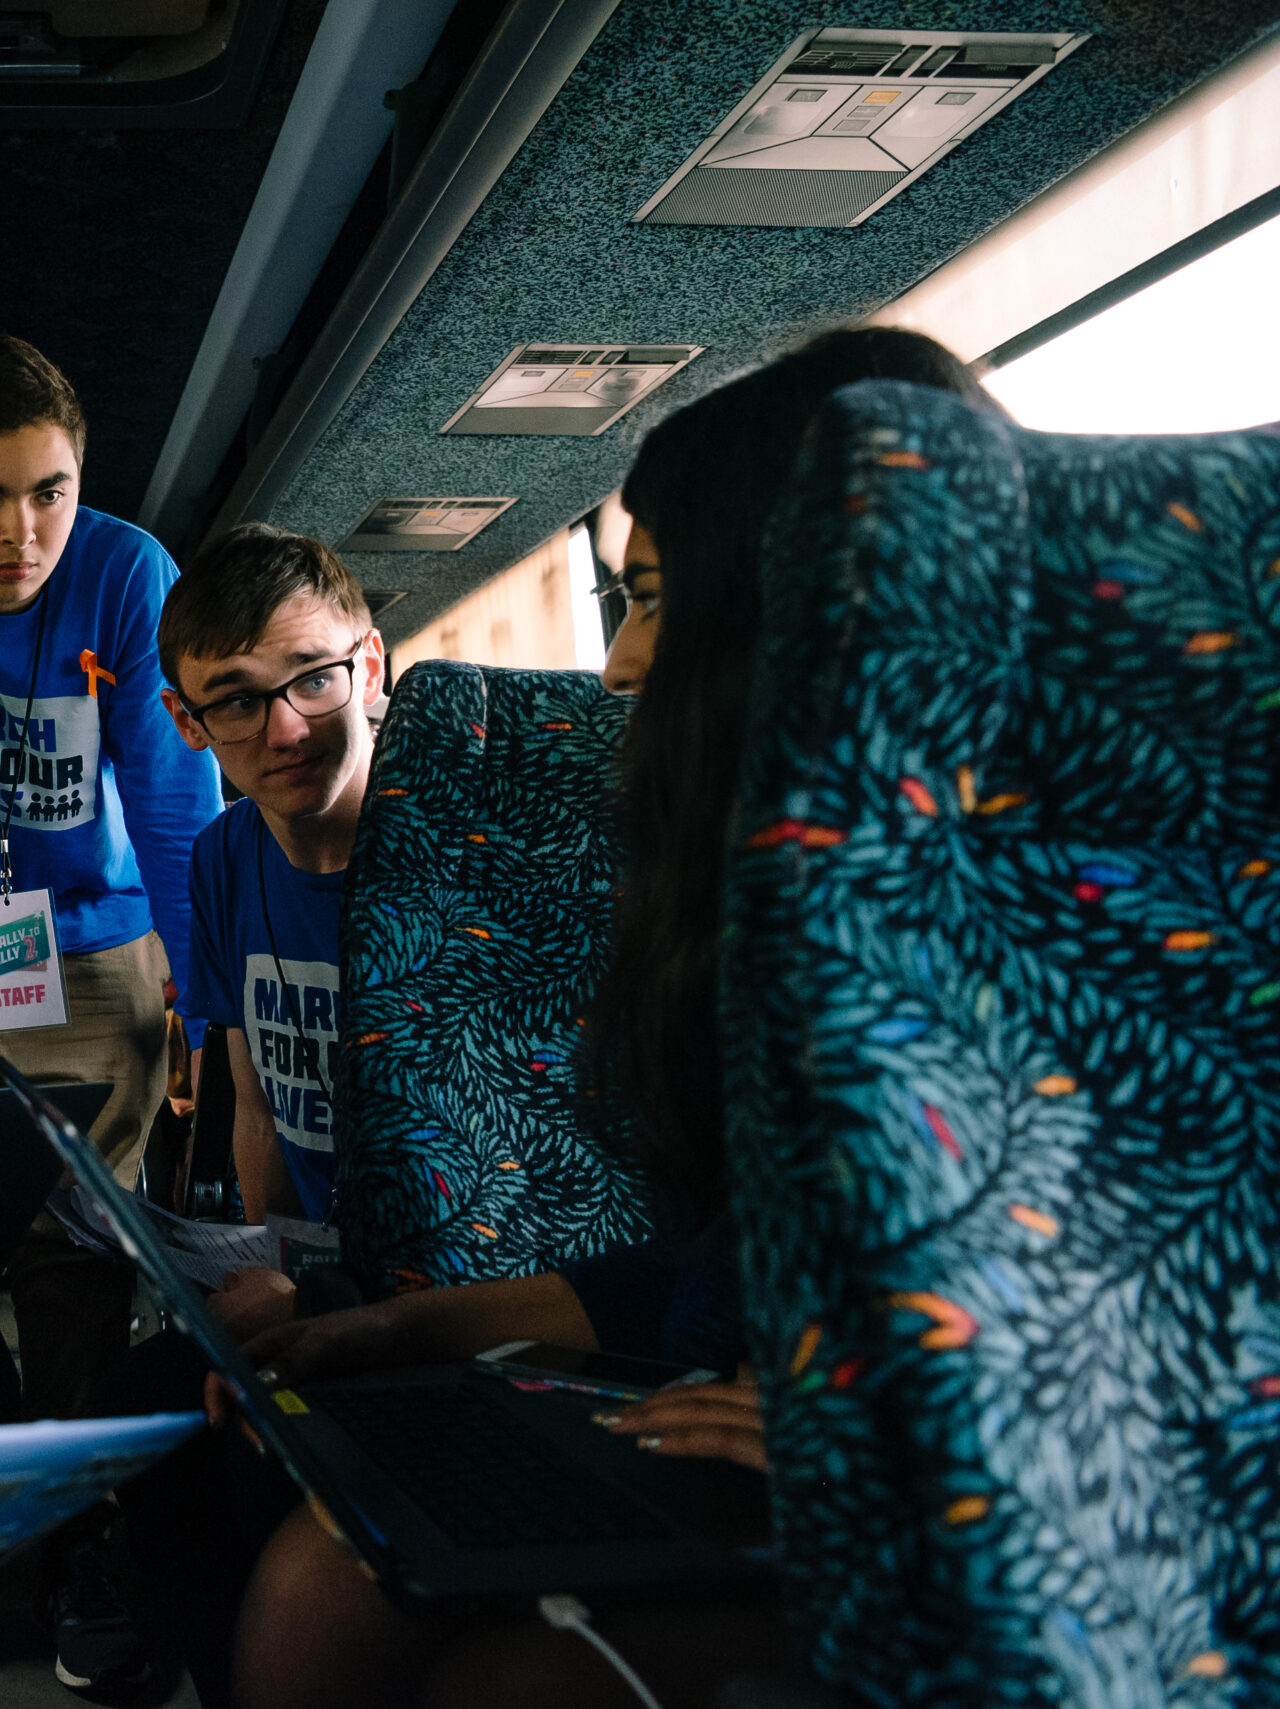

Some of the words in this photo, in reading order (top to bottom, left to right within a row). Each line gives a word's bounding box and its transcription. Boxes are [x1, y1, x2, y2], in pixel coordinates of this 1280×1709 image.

[23, 935, 38, 962] 2
[29, 926, 41, 937] TO
[255, 978, 340, 1032] MAR
[258, 1027, 320, 1080] FOR
[264, 1076, 333, 1134] LIVE
